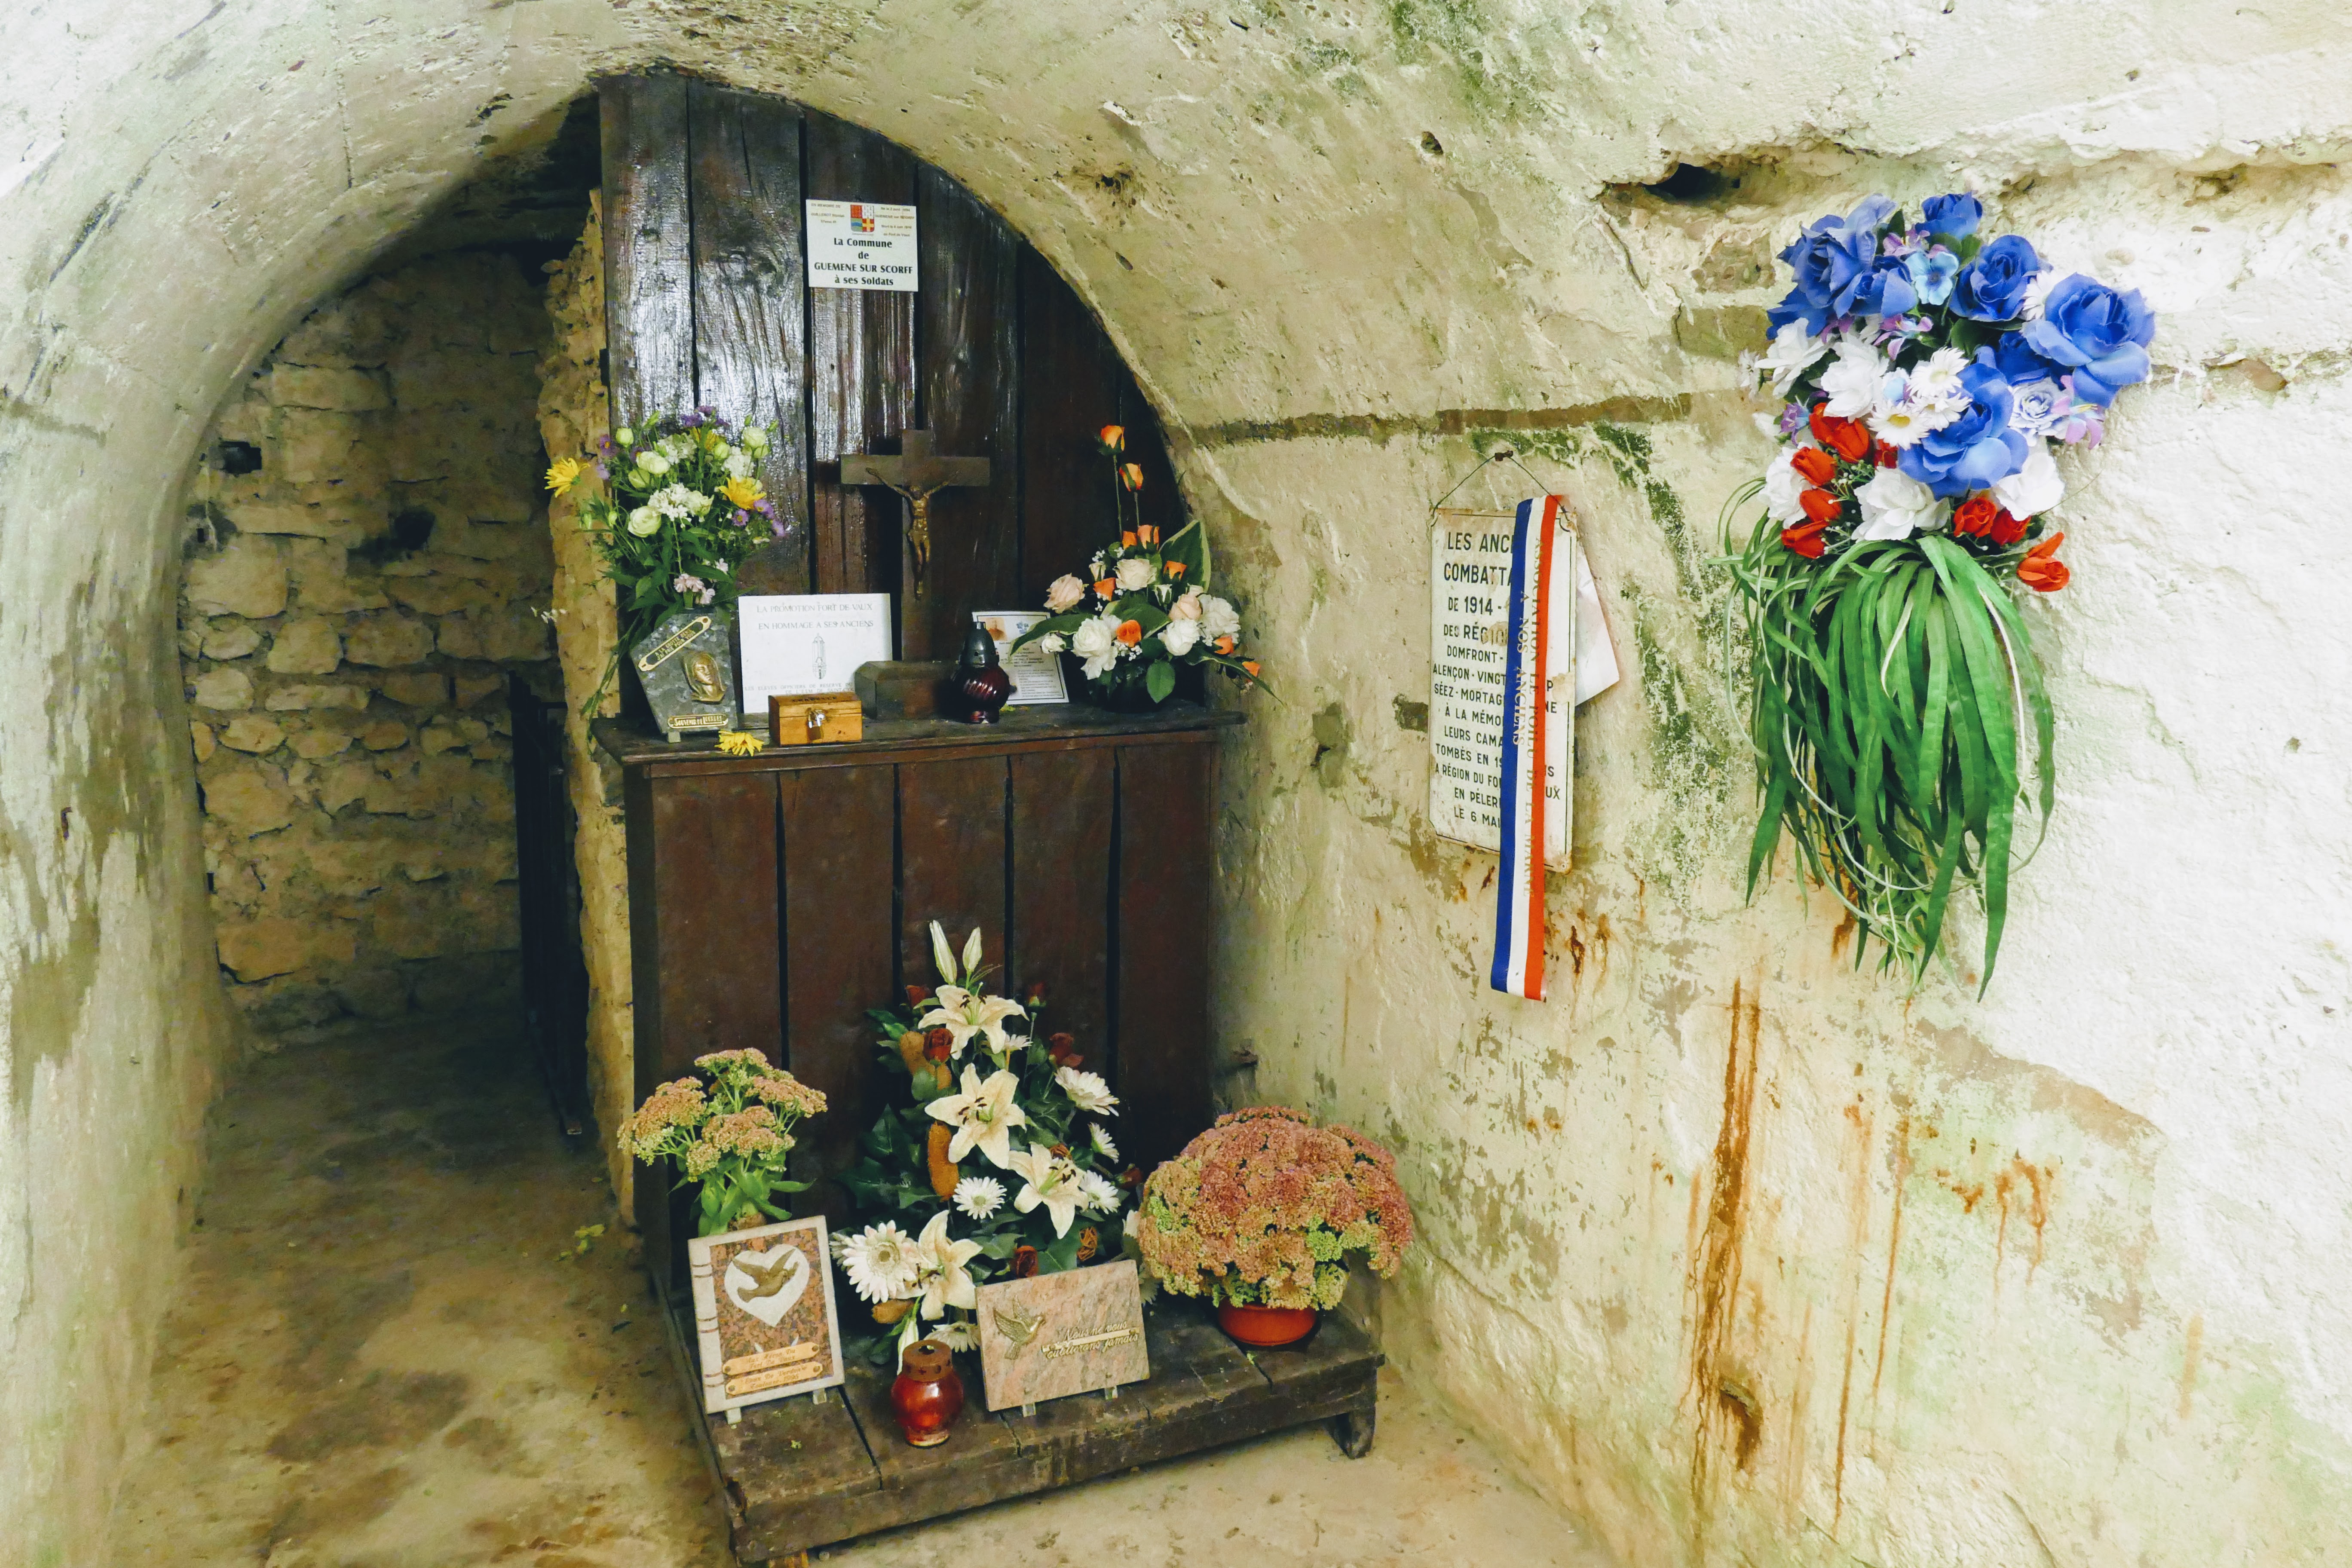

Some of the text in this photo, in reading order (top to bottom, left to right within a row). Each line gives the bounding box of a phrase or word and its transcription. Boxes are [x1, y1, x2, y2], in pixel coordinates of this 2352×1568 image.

[834, 237, 892, 248] La Commune
[858, 251, 870, 259] de
[814, 262, 913, 274] GUEMENE SUR SCORFF
[835, 275, 840, 284] à
[861, 277, 894, 285] Soldats
[1448, 532, 1472, 550] LES
[770, 604, 815, 612] PROMOTION
[1448, 597, 1458, 611] DE
[1464, 596, 1493, 616] 1914
[1531, 538, 1544, 661] ASSOCIATION
[1447, 645, 1497, 663] DOMFRONT
[1433, 663, 1470, 682] ALENÇON
[1513, 591, 1529, 745] A NOS ANCIENS
[1434, 681, 1454, 697] SÉEZ
[1461, 689, 1505, 705] MORTAG
[1529, 674, 1539, 695] LE
[1445, 702, 1504, 726] À LA MÉMO
[1444, 726, 1470, 741] LEURS
[1436, 744, 1471, 761] TOMBÉS
[1477, 753, 1488, 766] EN
[1442, 763, 1470, 781] RÉGION
[1473, 772, 1483, 784] DU
[1526, 769, 1537, 792] DE
[1455, 787, 1464, 800] EN
[1454, 806, 1464, 819] LE
[1471, 812, 1476, 822] 6
[1525, 802, 1535, 824] LA
[1065, 1326, 1088, 1341] Nous
[1105, 1321, 1127, 1332] nous
[1102, 1334, 1138, 1354] jamais
